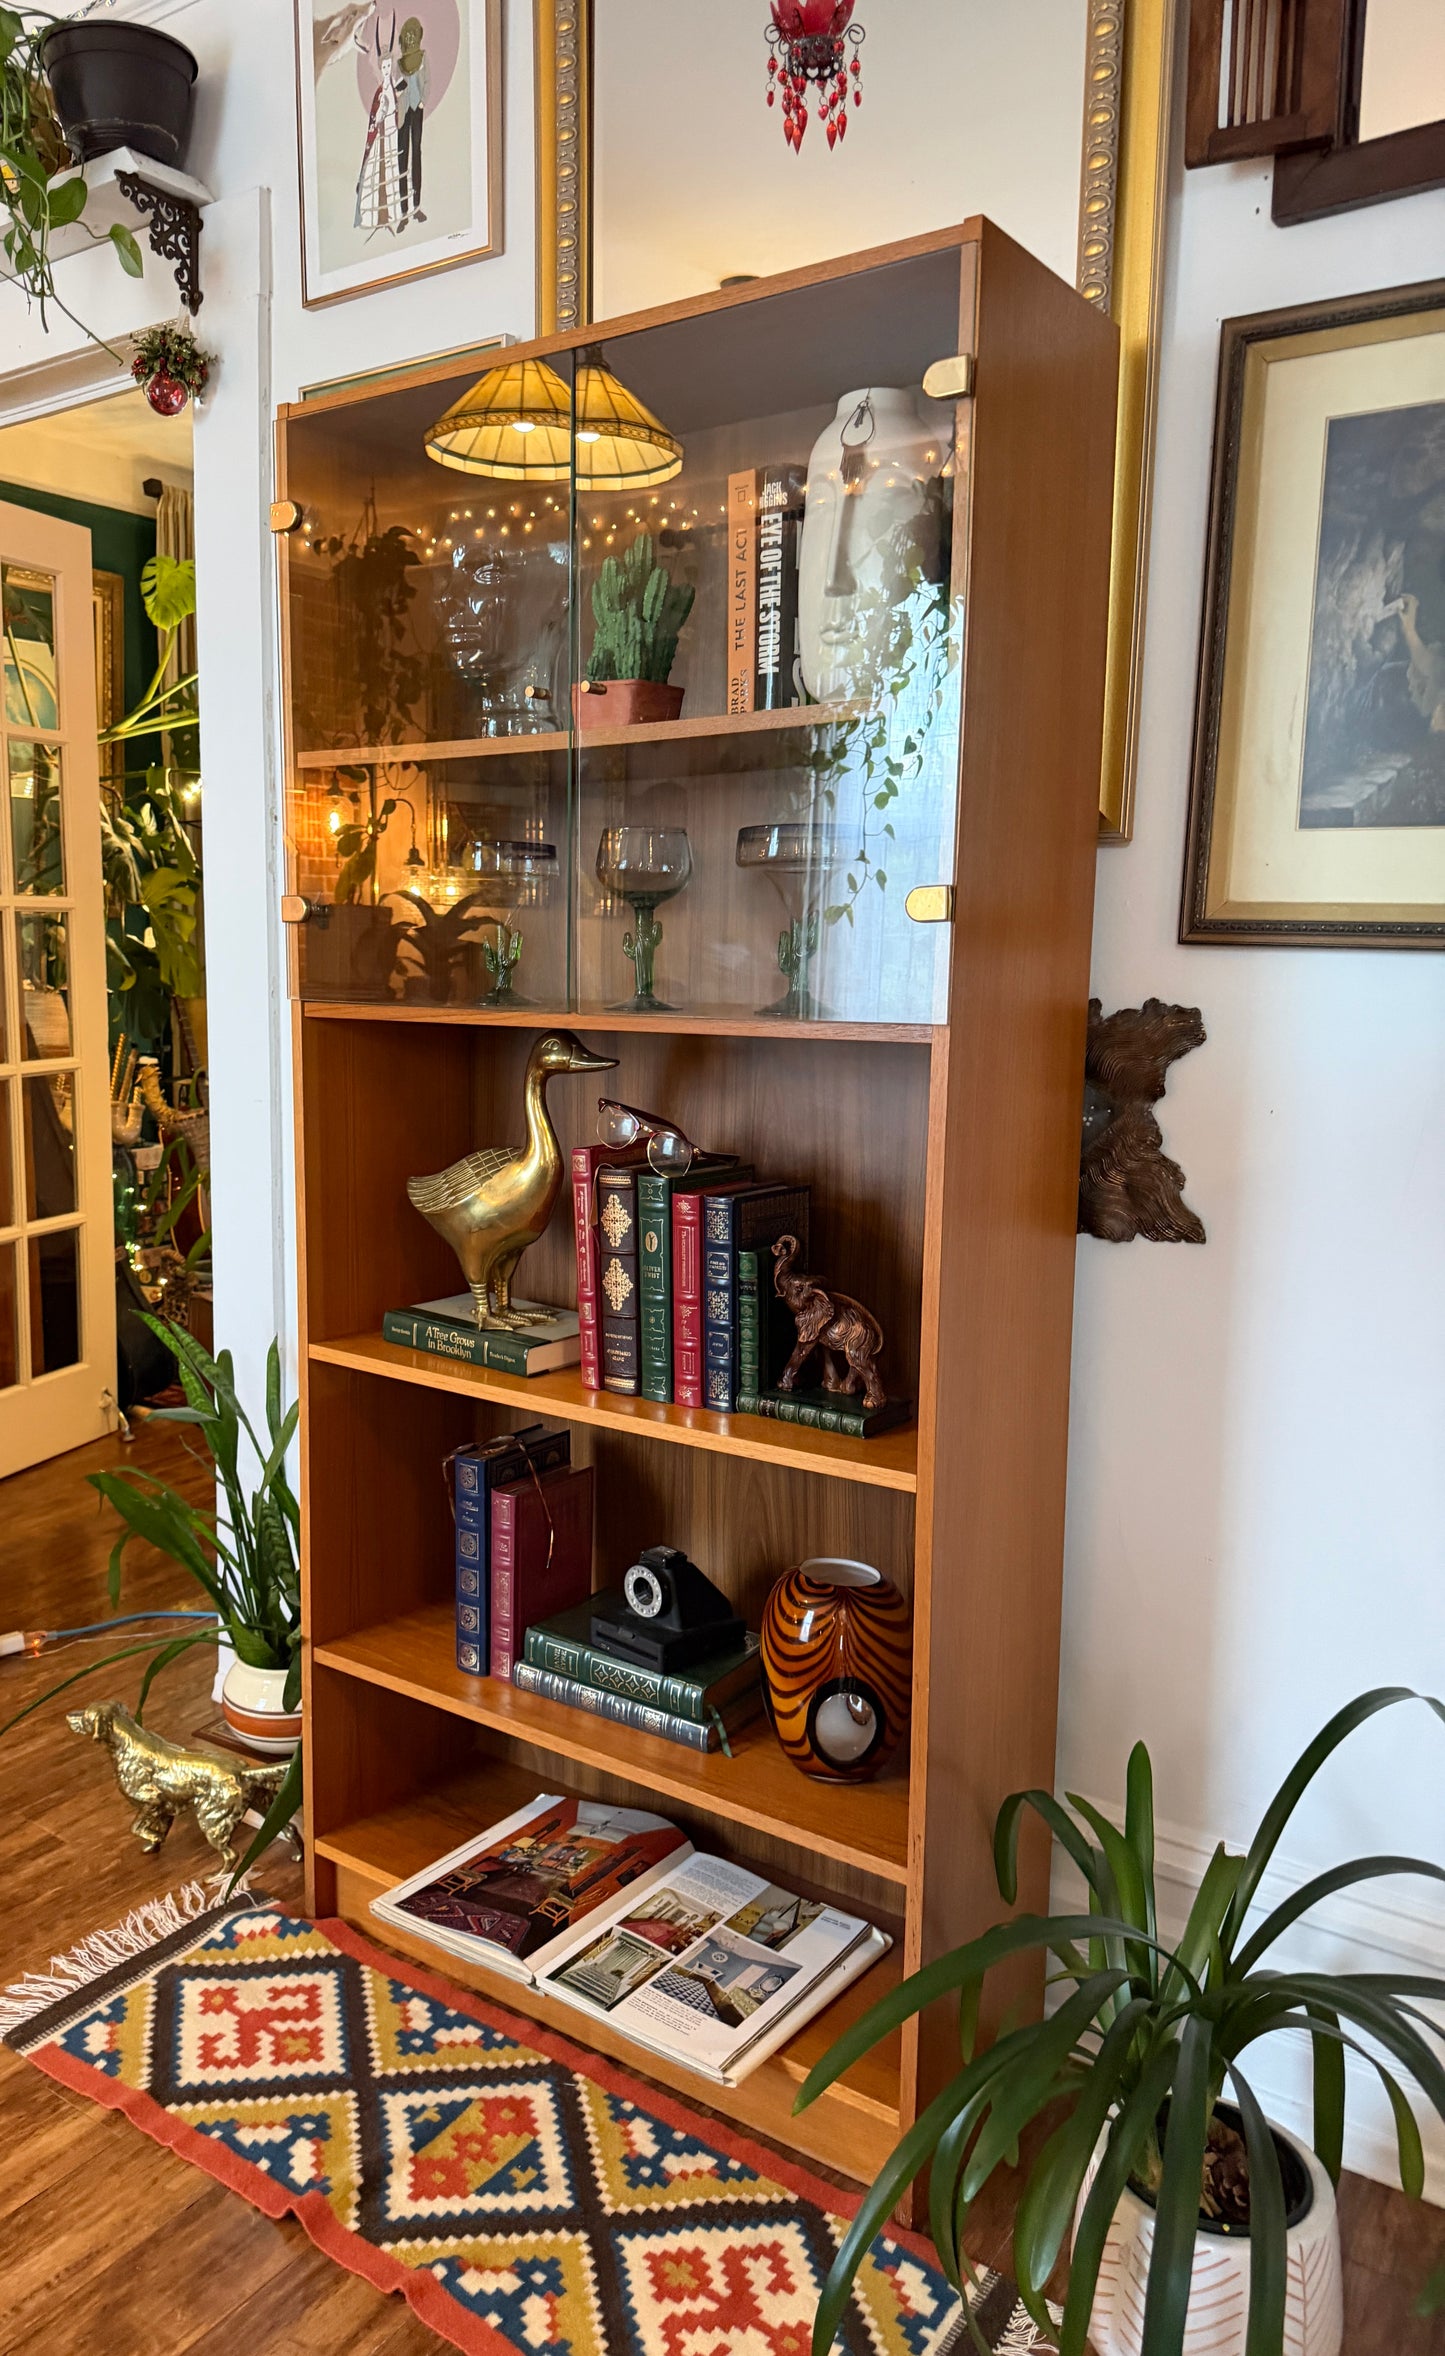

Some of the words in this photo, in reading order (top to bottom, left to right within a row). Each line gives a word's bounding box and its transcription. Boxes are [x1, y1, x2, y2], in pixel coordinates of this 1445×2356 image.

[759, 492, 788, 509] HIGGINS
[762, 481, 782, 496] JACK
[735, 529, 747, 562] ACT
[761, 512, 782, 548] EYE
[760, 548, 782, 574] OF
[735, 569, 746, 611] LAST
[760, 572, 781, 609] THE
[735, 618, 746, 651] THE
[758, 610, 780, 675] STORM
[731, 677, 741, 714] BRAD
[740, 669, 748, 714] PARKS
[426, 1326, 432, 1337] A
[432, 1327, 449, 1341] Tree
[449, 1332, 475, 1348] Grows
[428, 1338, 436, 1349] in
[437, 1340, 472, 1359] Brooklyn
